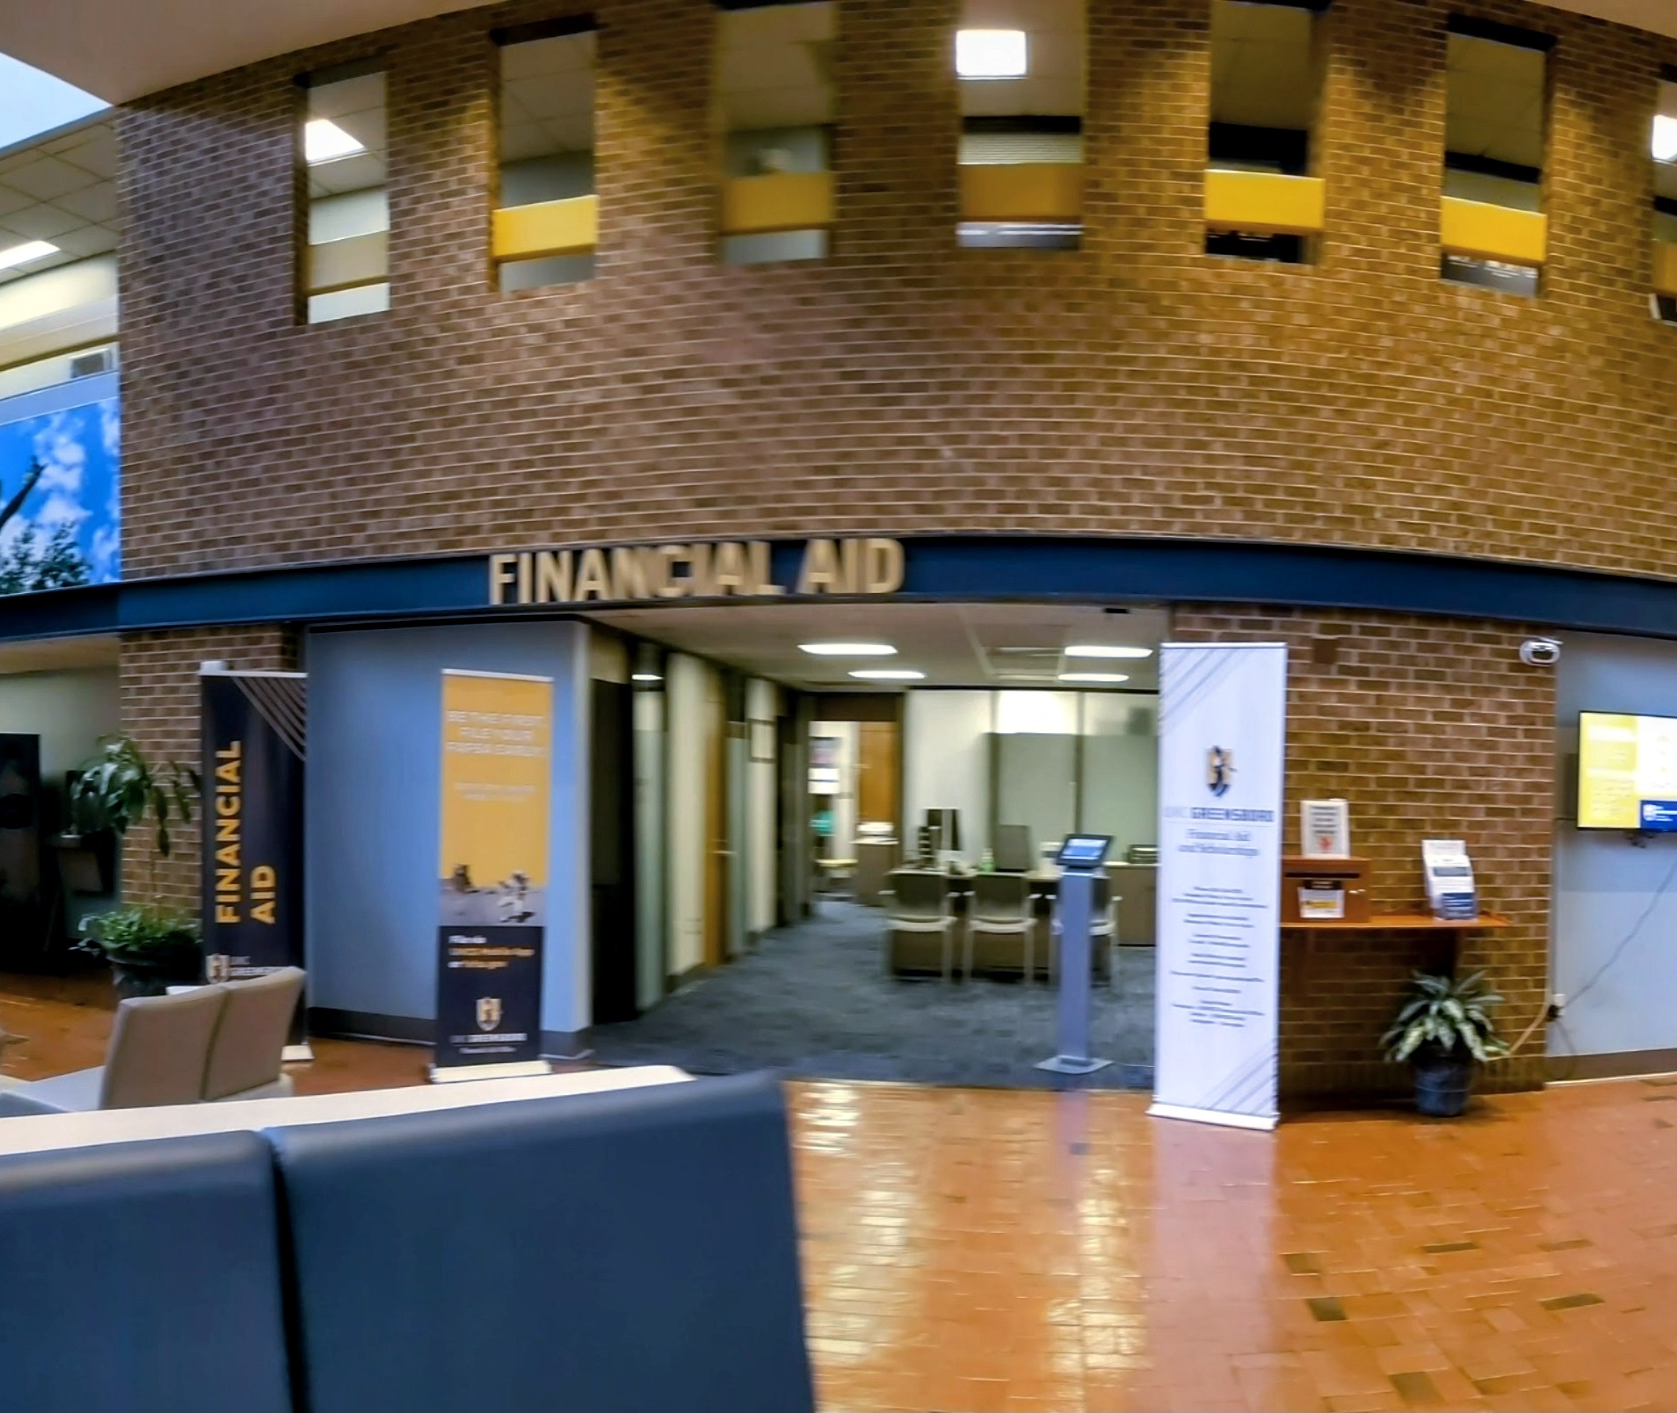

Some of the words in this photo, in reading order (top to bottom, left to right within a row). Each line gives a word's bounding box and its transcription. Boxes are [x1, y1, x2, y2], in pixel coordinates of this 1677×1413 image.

[490, 539, 787, 605] FINANCIAL
[796, 536, 905, 595] AID
[215, 740, 241, 924] FINANCIAL
[1190, 807, 1275, 822] GREENSBORO
[250, 865, 276, 924] AID
